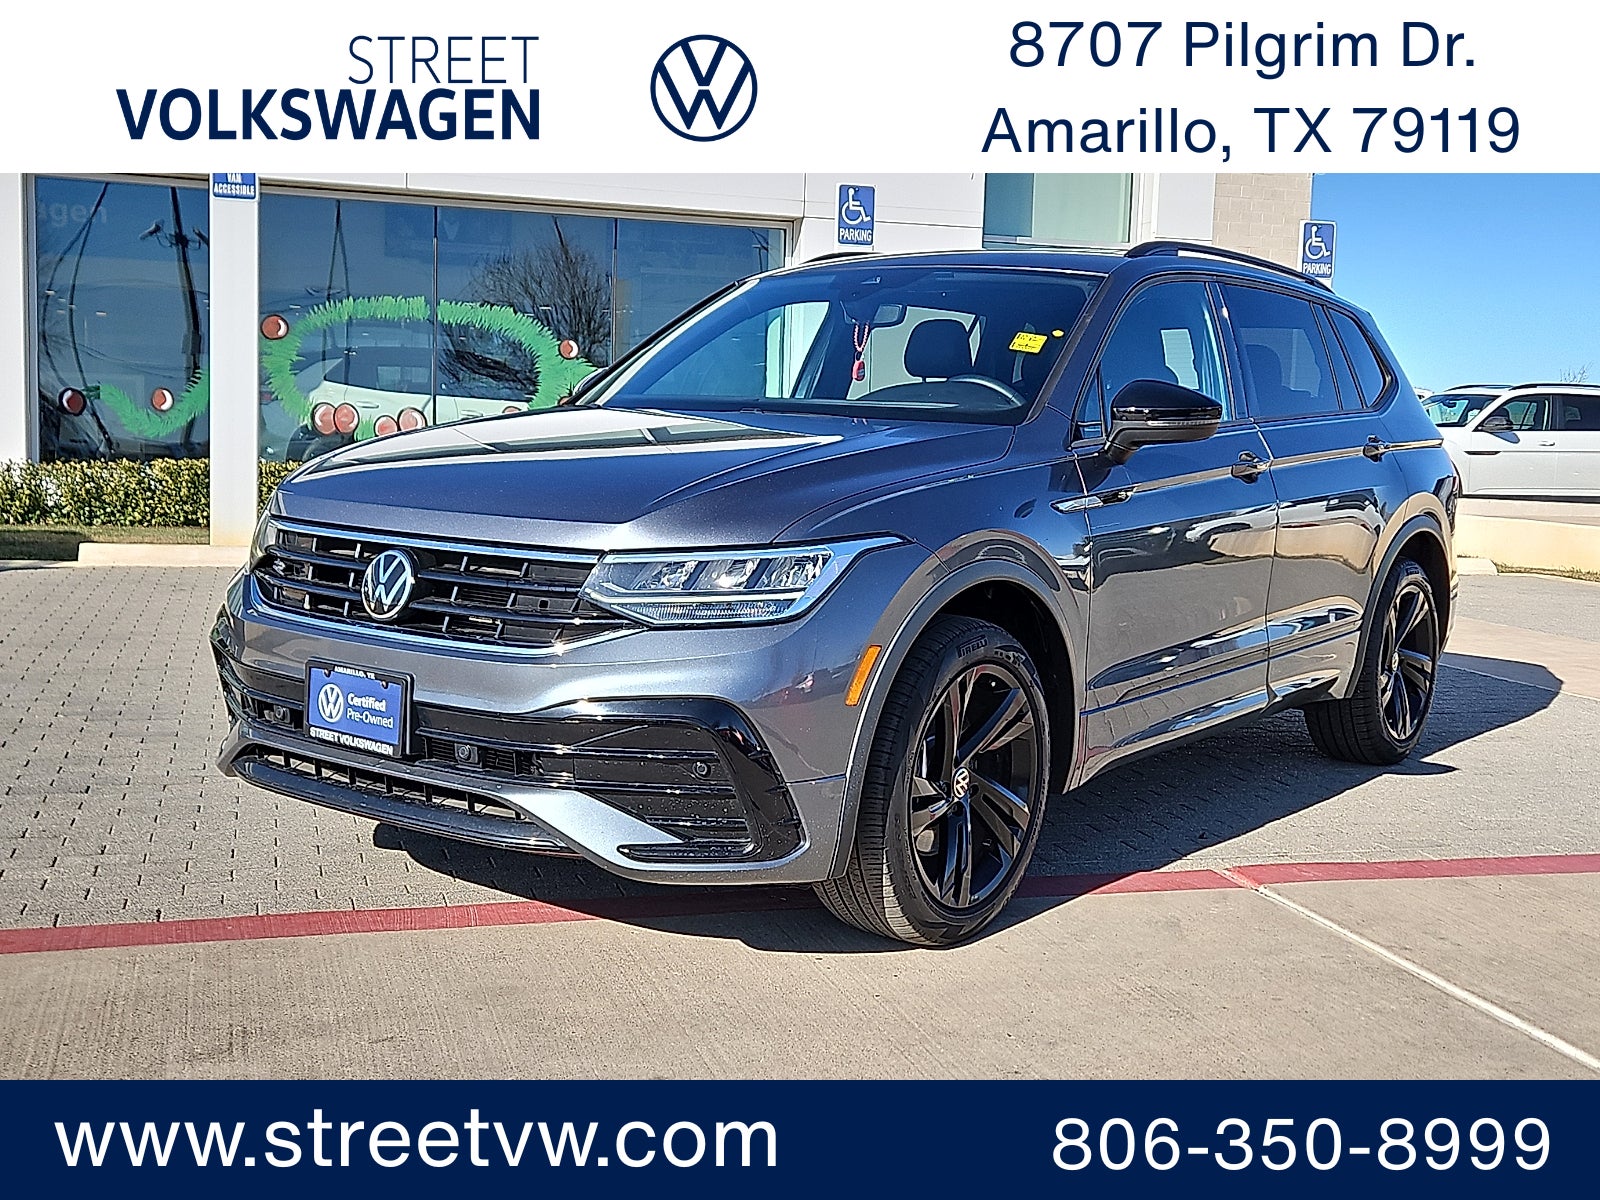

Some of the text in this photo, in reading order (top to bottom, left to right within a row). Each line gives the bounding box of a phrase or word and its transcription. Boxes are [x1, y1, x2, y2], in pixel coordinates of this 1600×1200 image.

[213, 182, 255, 196] ACCESSIBLE
[839, 227, 872, 242] PARKING
[1302, 262, 1332, 275] PARKING
[957, 636, 988, 658] PIRELLI
[347, 692, 386, 712] Certified
[346, 707, 394, 729] Pre-Owned
[309, 727, 394, 756] STREET VOLKSWAGEN
